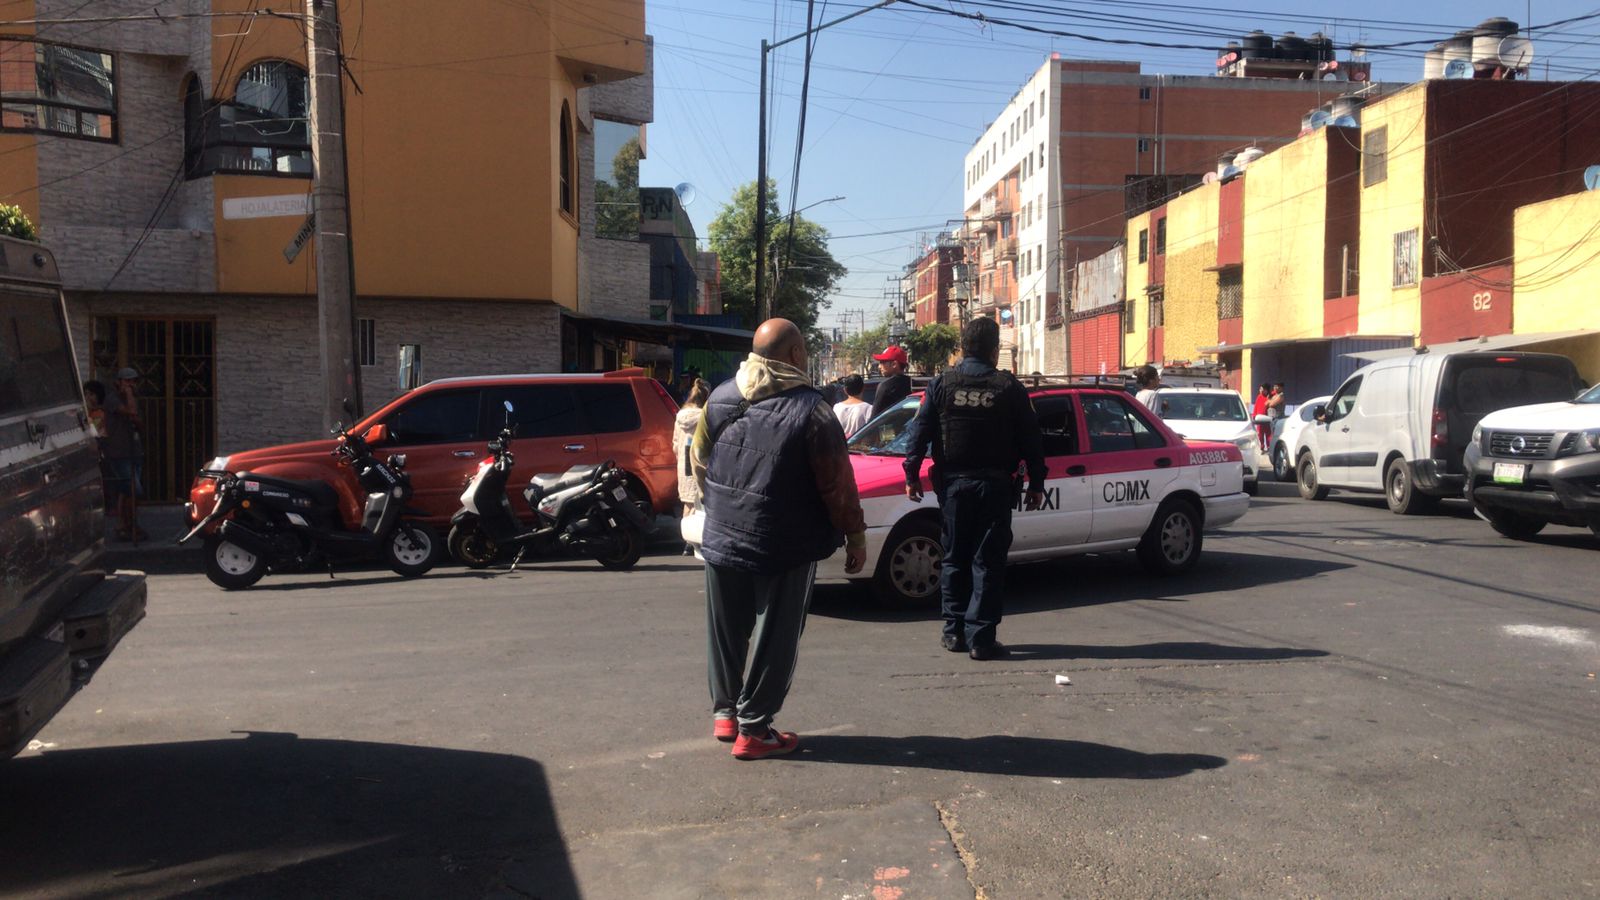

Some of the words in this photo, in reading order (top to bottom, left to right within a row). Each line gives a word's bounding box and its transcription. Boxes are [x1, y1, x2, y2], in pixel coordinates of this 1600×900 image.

[1473, 292, 1492, 310] 82
[953, 390, 994, 408] SSC
[1015, 487, 1060, 512] TXI
[1103, 479, 1150, 503] CDMX
